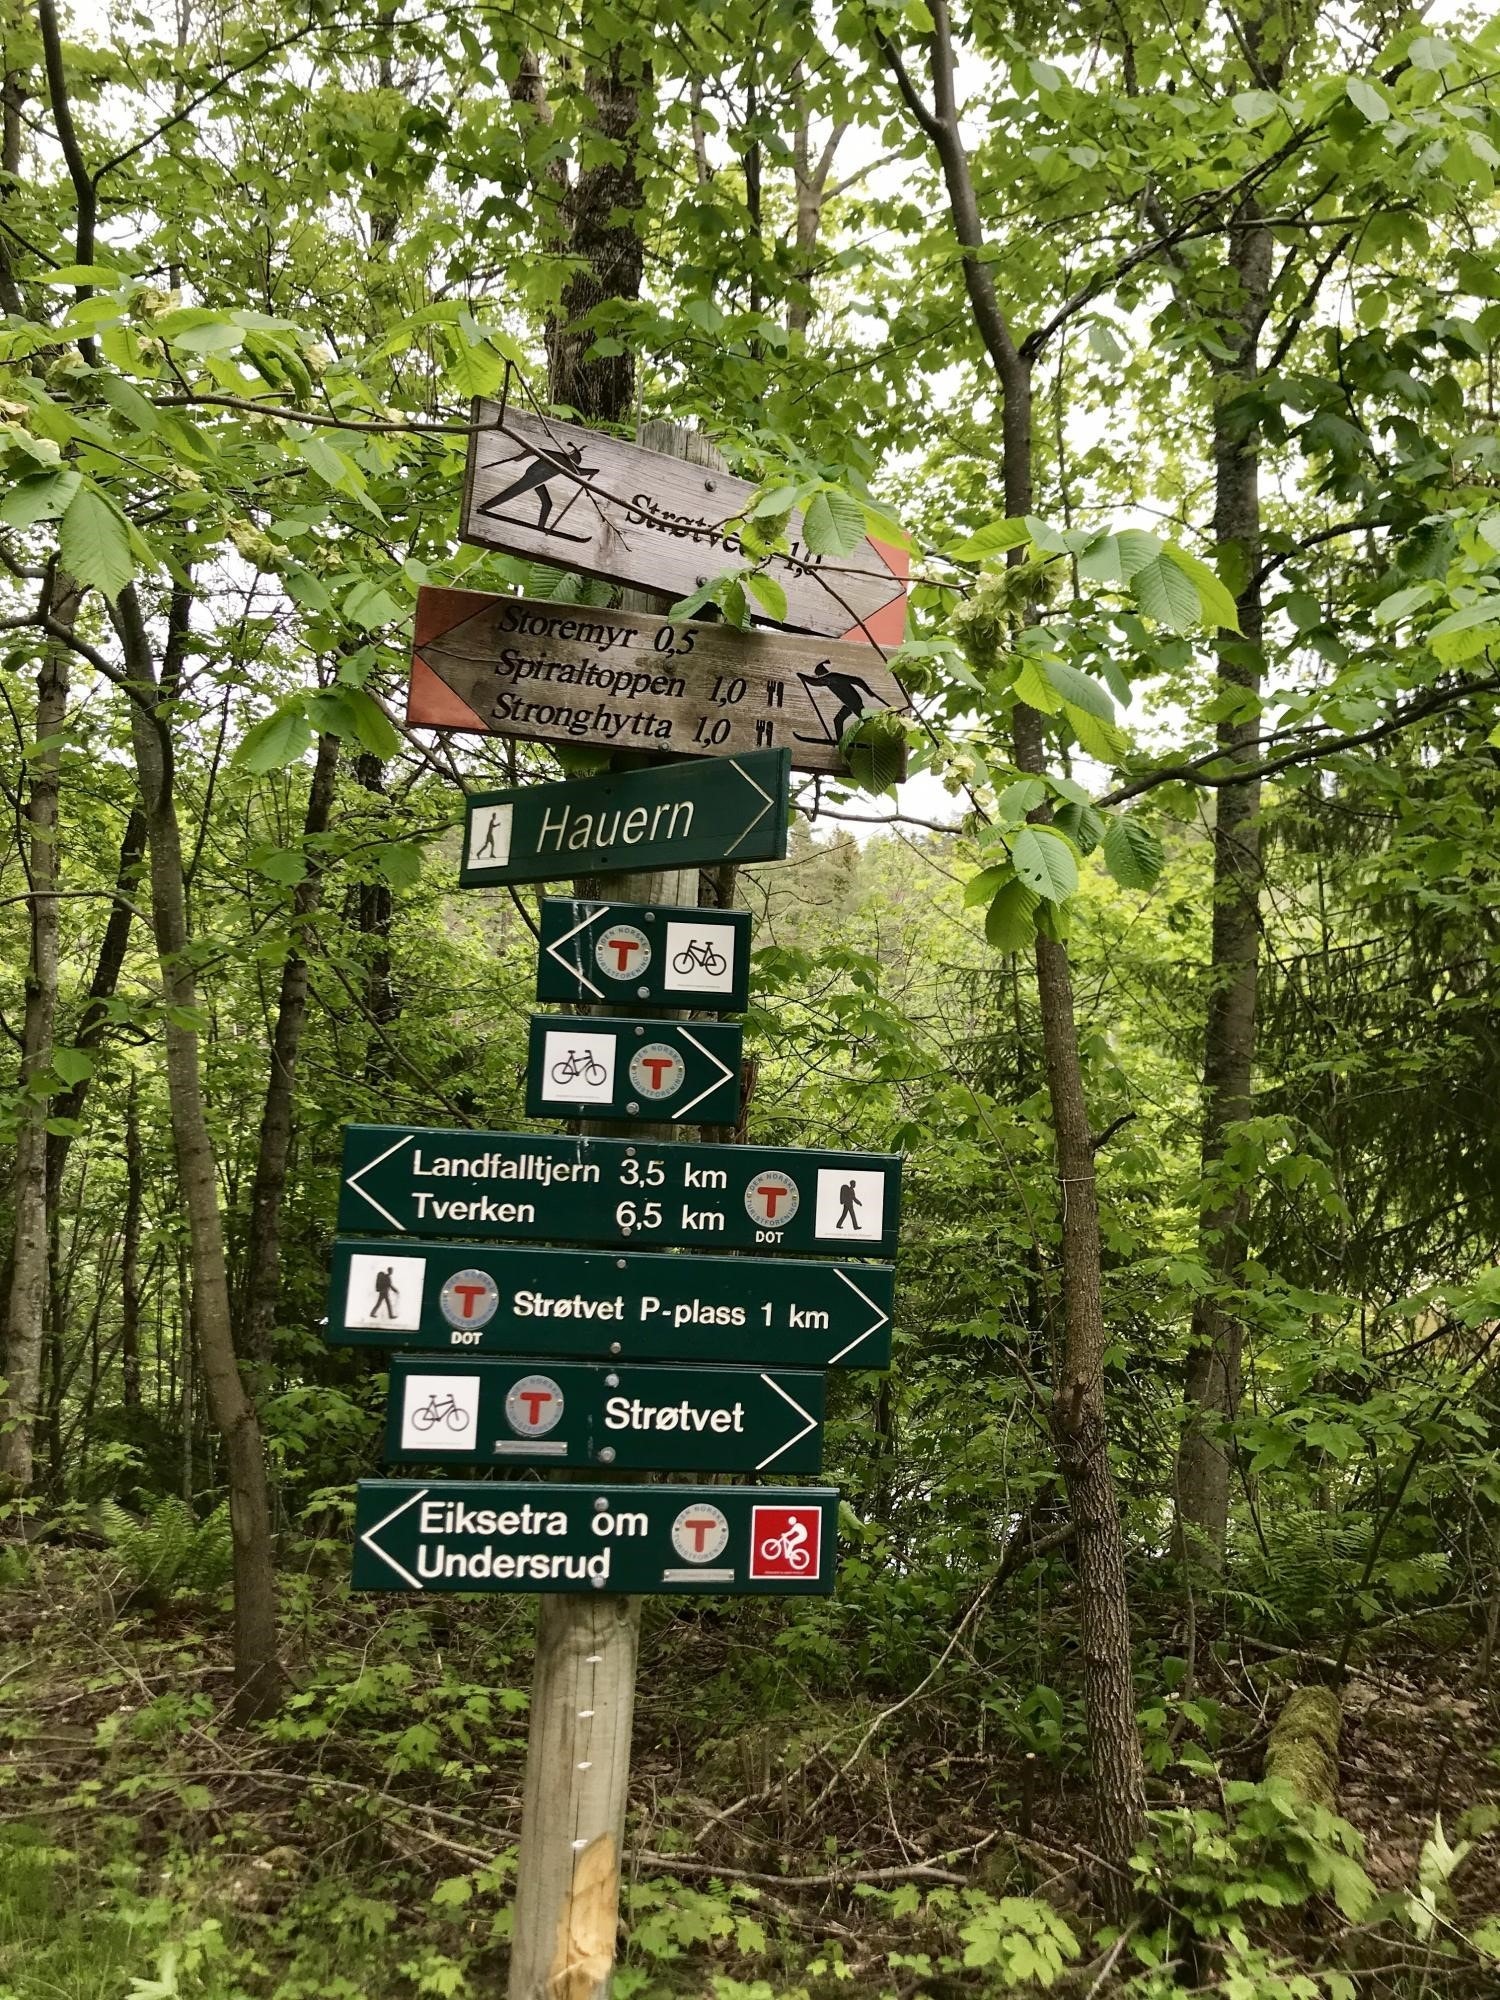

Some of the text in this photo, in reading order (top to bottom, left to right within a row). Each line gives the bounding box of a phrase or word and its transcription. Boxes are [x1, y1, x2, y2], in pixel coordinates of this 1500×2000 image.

[498, 605, 699, 658] Storemyr 0,5
[494, 648, 747, 707] Spiraltoppen 1,0
[491, 692, 731, 748] Stronghytta 1,0
[536, 801, 694, 853] Hauern
[600, 927, 648, 947] DEN NORSKE
[608, 940, 639, 971] T
[642, 1058, 673, 1089] T
[413, 1150, 727, 1189] Landfalltjern 3,5 km
[412, 1193, 725, 1233] Tverken 6,5 km
[757, 1187, 788, 1218] T
[755, 1230, 784, 1243] DOT
[454, 1285, 486, 1318] T
[513, 1291, 625, 1321] Strøtvet
[640, 1297, 746, 1328] P-plass
[760, 1303, 773, 1326] 1
[789, 1304, 829, 1329] km
[451, 1331, 483, 1345] DOT
[520, 1392, 552, 1425] T
[604, 1396, 745, 1433] Strøtvet
[419, 1501, 649, 1537] Eiksetra om
[685, 1519, 717, 1553] T
[417, 1544, 611, 1579] Undersrud
